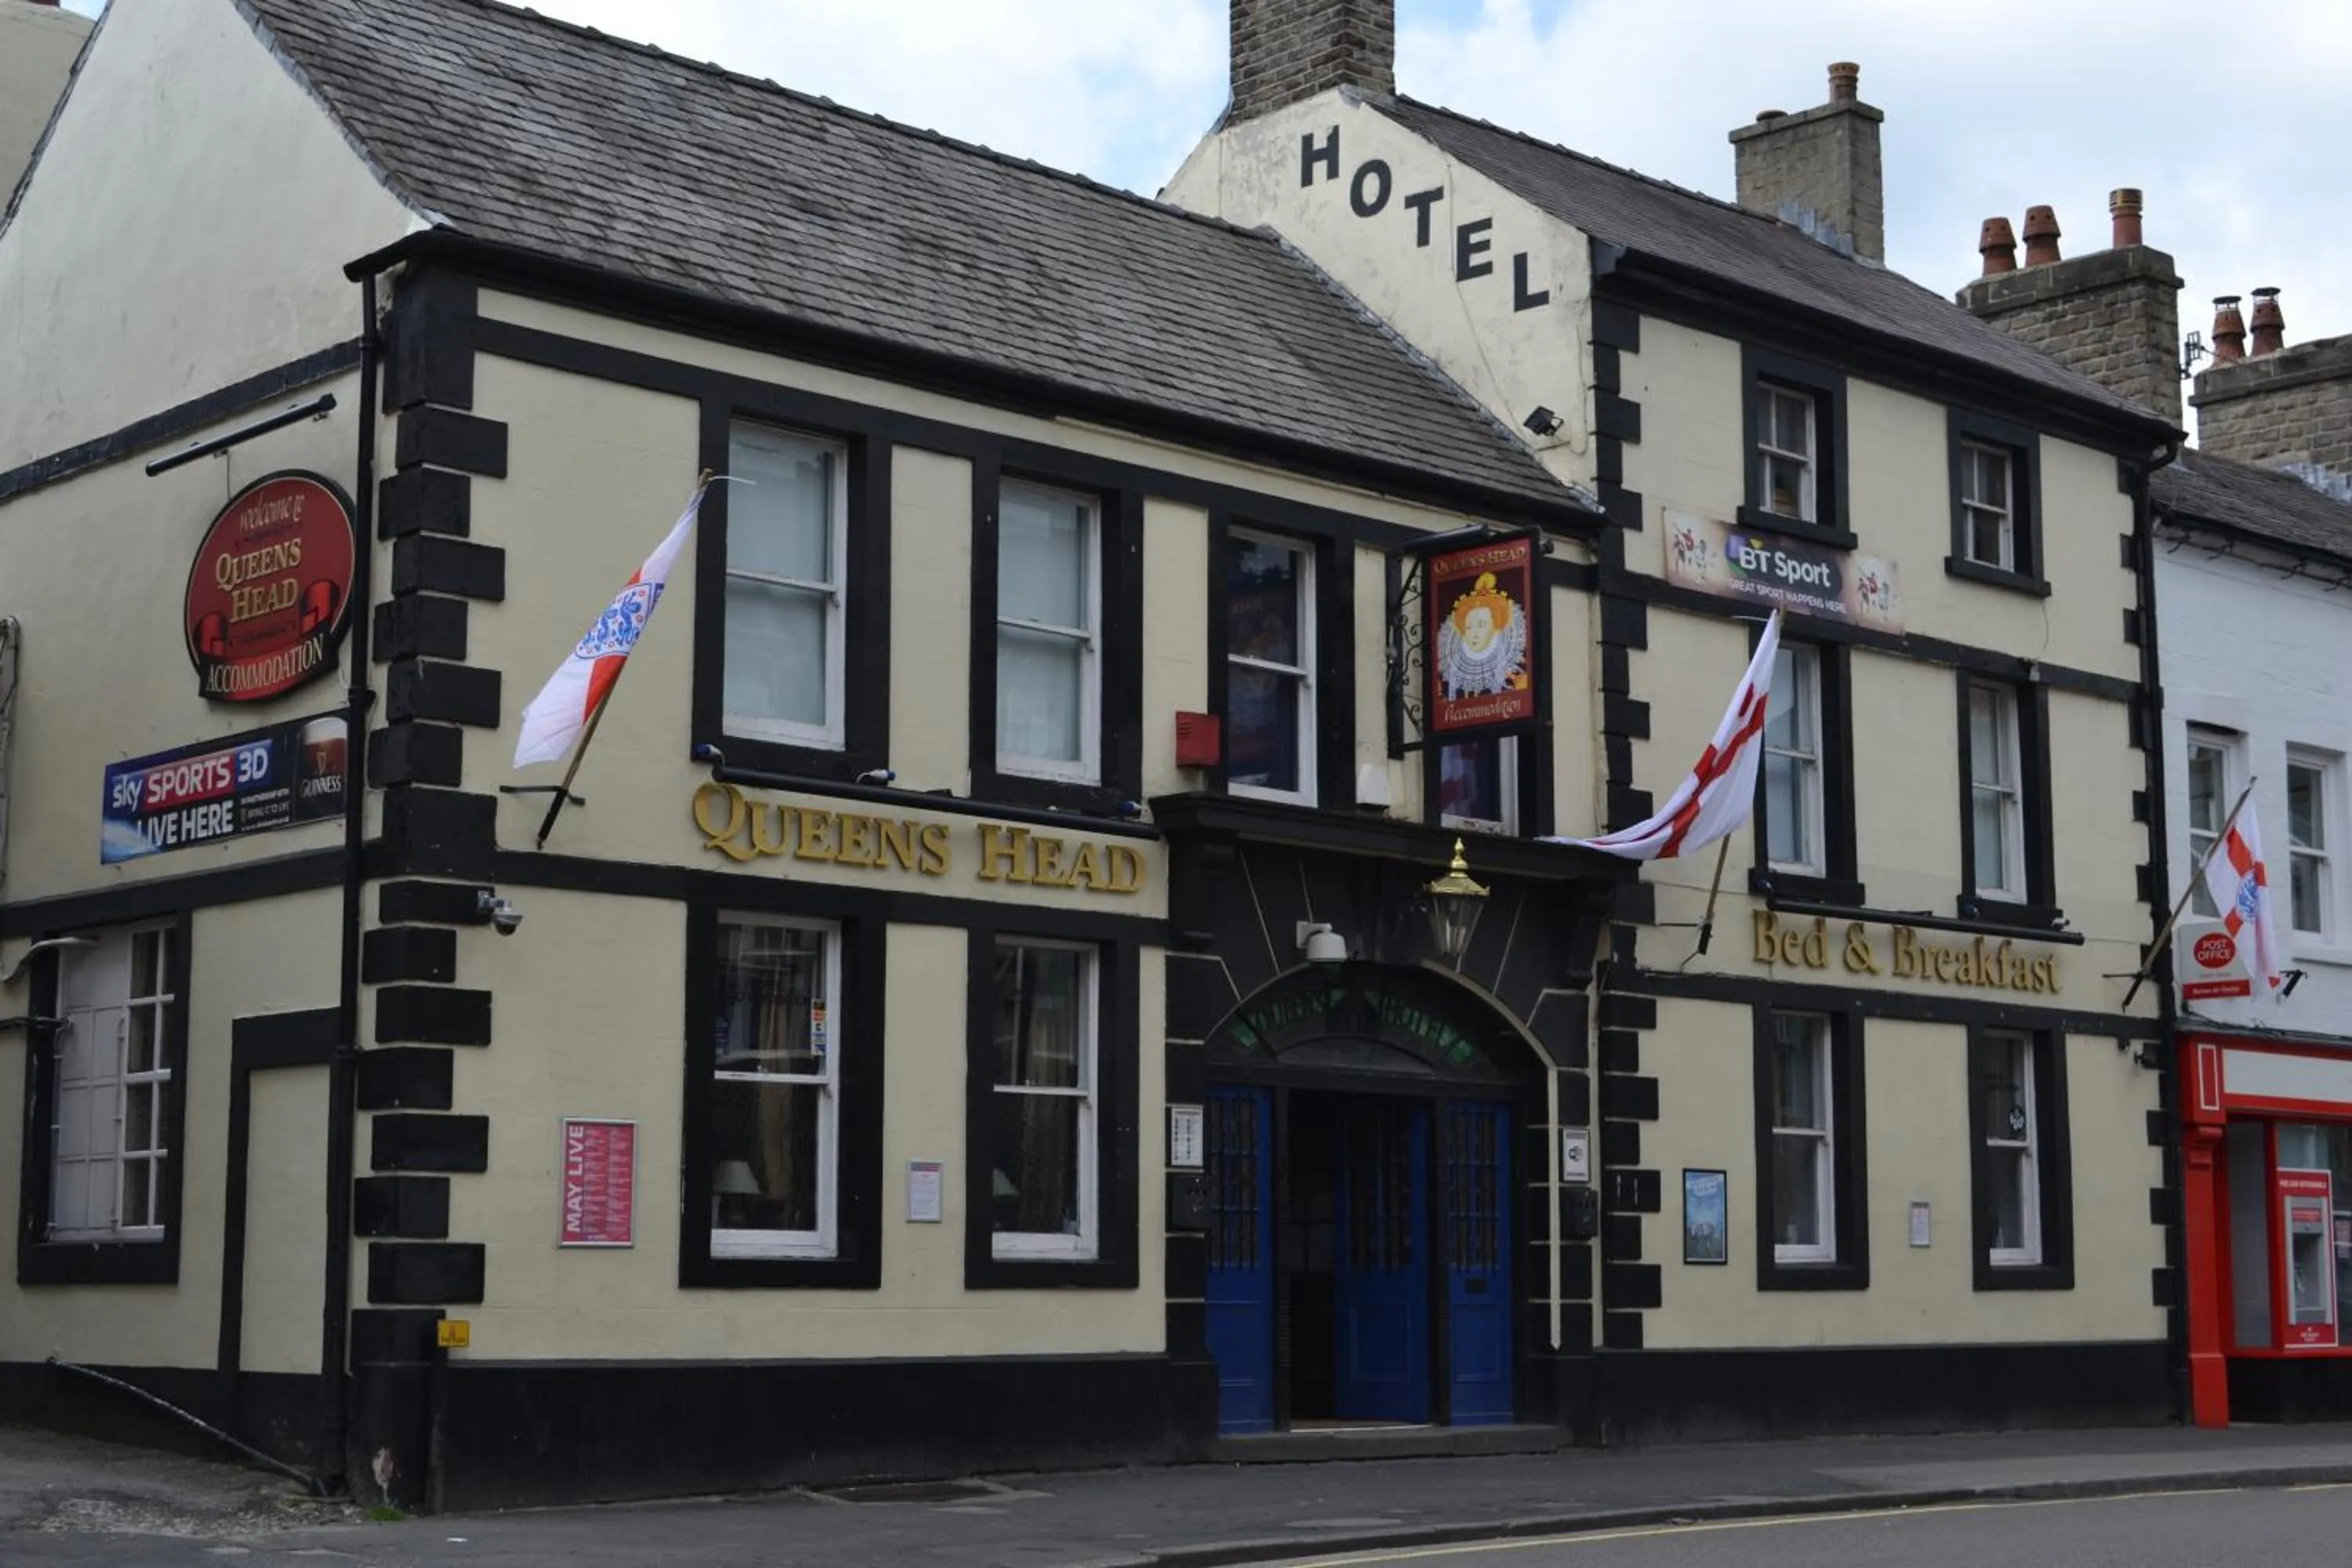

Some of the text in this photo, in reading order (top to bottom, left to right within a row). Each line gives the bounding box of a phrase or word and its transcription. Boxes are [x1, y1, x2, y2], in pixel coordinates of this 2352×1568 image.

[1301, 125, 1549, 313] HOTEL
[216, 537, 303, 592] QUEENS
[1487, 546, 1526, 564] HEAD
[1739, 546, 1831, 587] BT Sport
[230, 578, 299, 622] HEAD
[1757, 584, 1784, 601] SPORT
[206, 633, 325, 693] ACCOMMODATION
[112, 774, 143, 811] sky
[147, 756, 232, 804] SPORTS
[238, 748, 268, 783] 3D
[301, 775, 343, 798] GUINNESS
[137, 800, 234, 848] LIVE HERE
[691, 782, 1148, 894] QUEENS HEAD
[1752, 909, 2060, 995] Bed & Breakfast
[2198, 949, 2231, 961] OFFICE
[2202, 939, 2227, 949] POST
[567, 1125, 584, 1232] MAY LIVE
